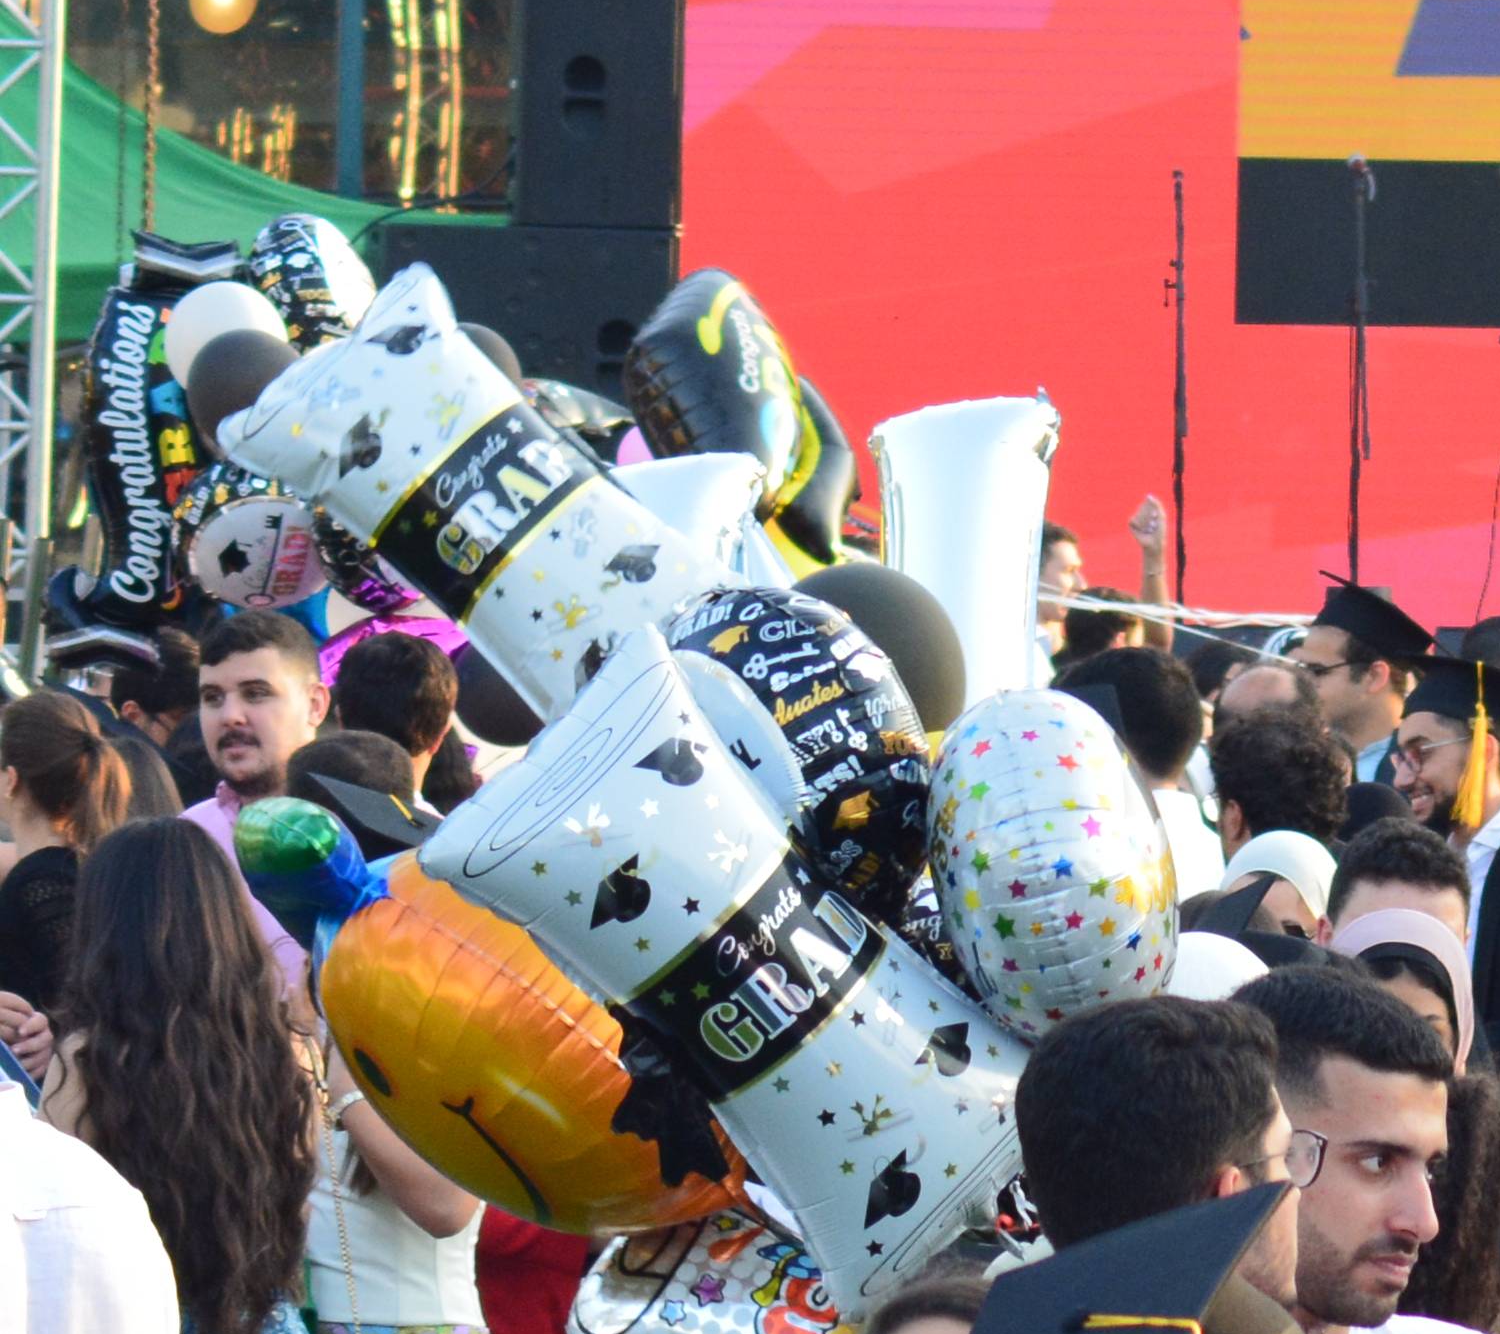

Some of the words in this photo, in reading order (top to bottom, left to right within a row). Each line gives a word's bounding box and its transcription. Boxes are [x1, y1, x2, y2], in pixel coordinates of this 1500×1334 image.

[98, 300, 171, 604] Congratulations
[436, 439, 574, 575] GRAD
[700, 890, 868, 1062] GRAD
[716, 886, 802, 978] Congrats
